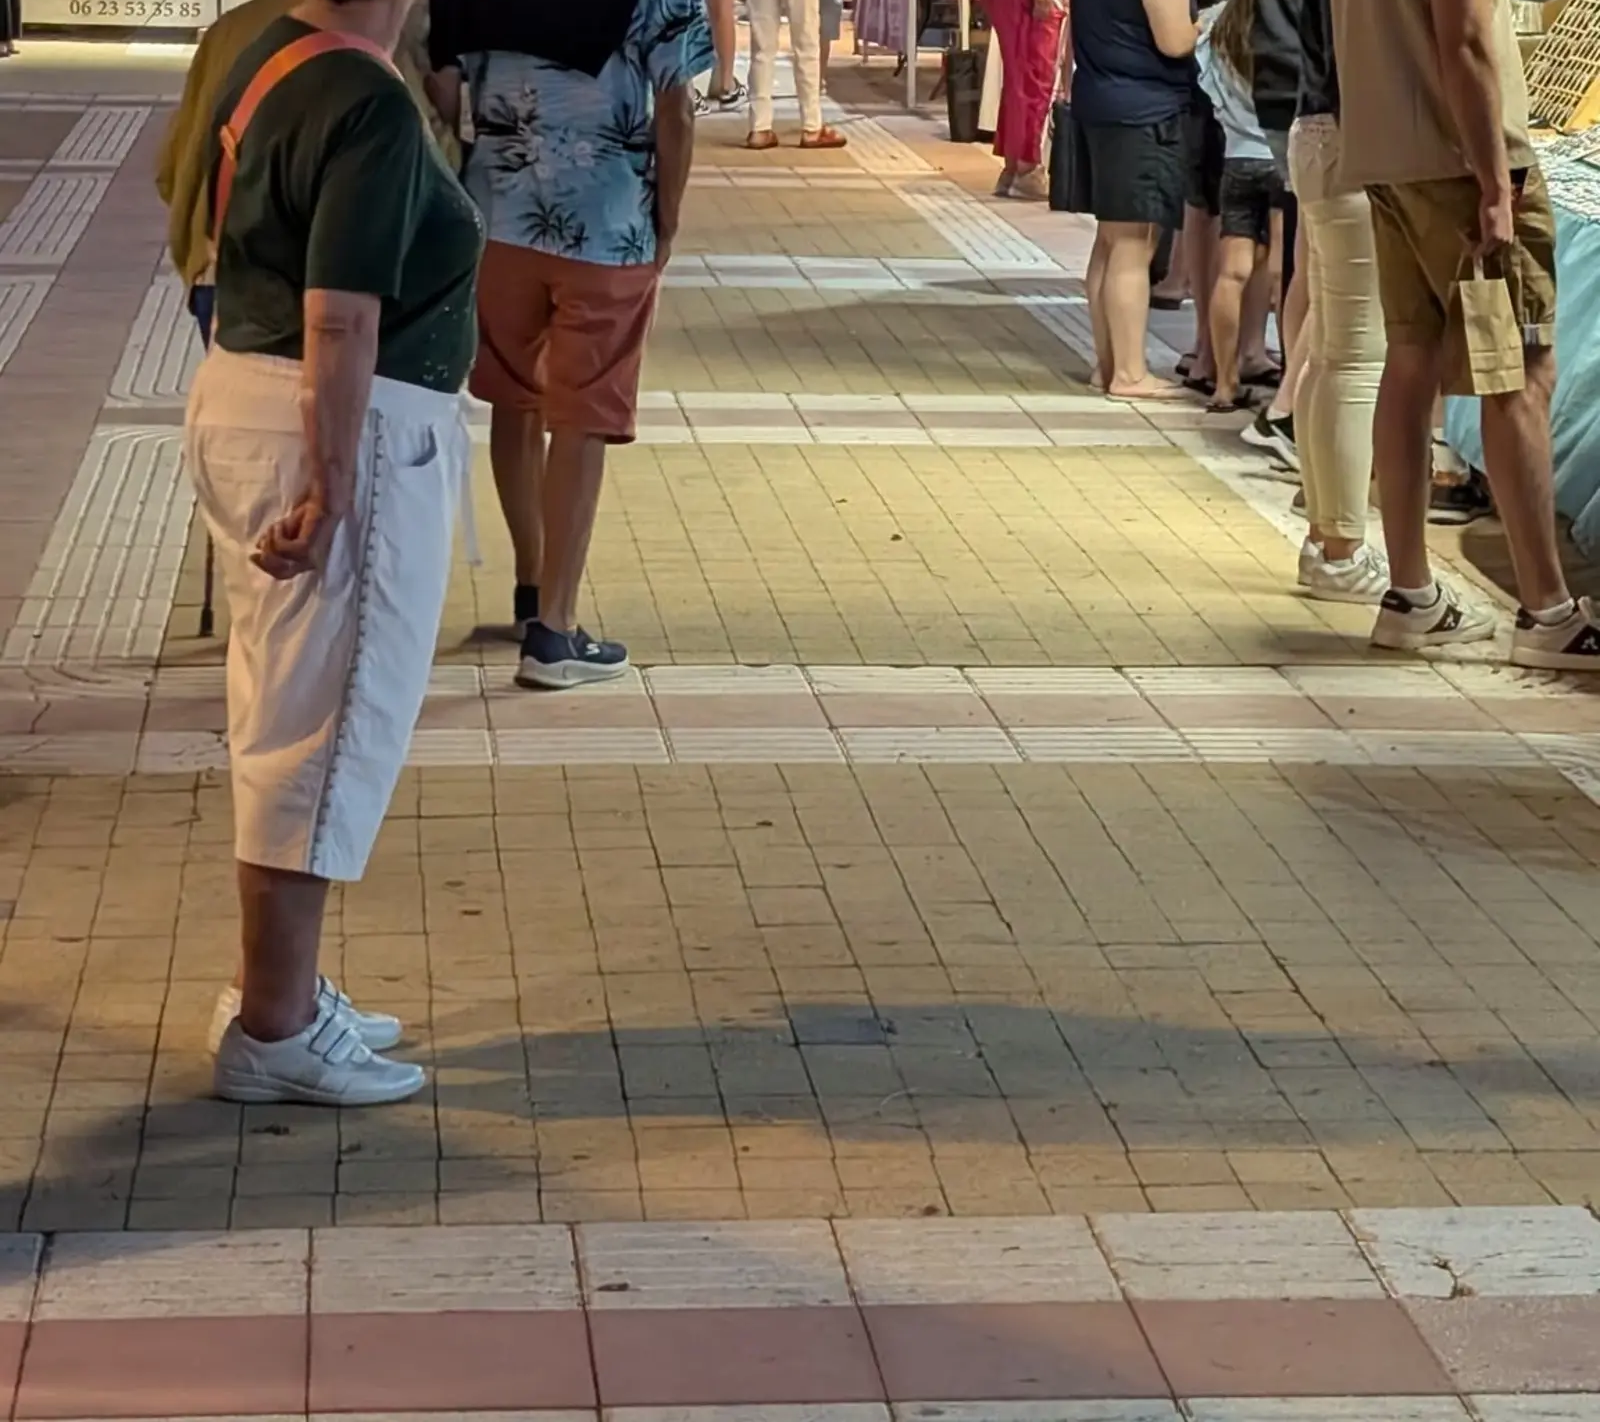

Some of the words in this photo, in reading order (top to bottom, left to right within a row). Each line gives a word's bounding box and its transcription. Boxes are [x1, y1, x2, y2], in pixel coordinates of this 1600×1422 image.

[69, 0, 92, 16] 06
[97, 0, 119, 16] 23
[124, 1, 146, 17] 53
[152, 2, 174, 18] 35
[179, 2, 201, 18] 85
